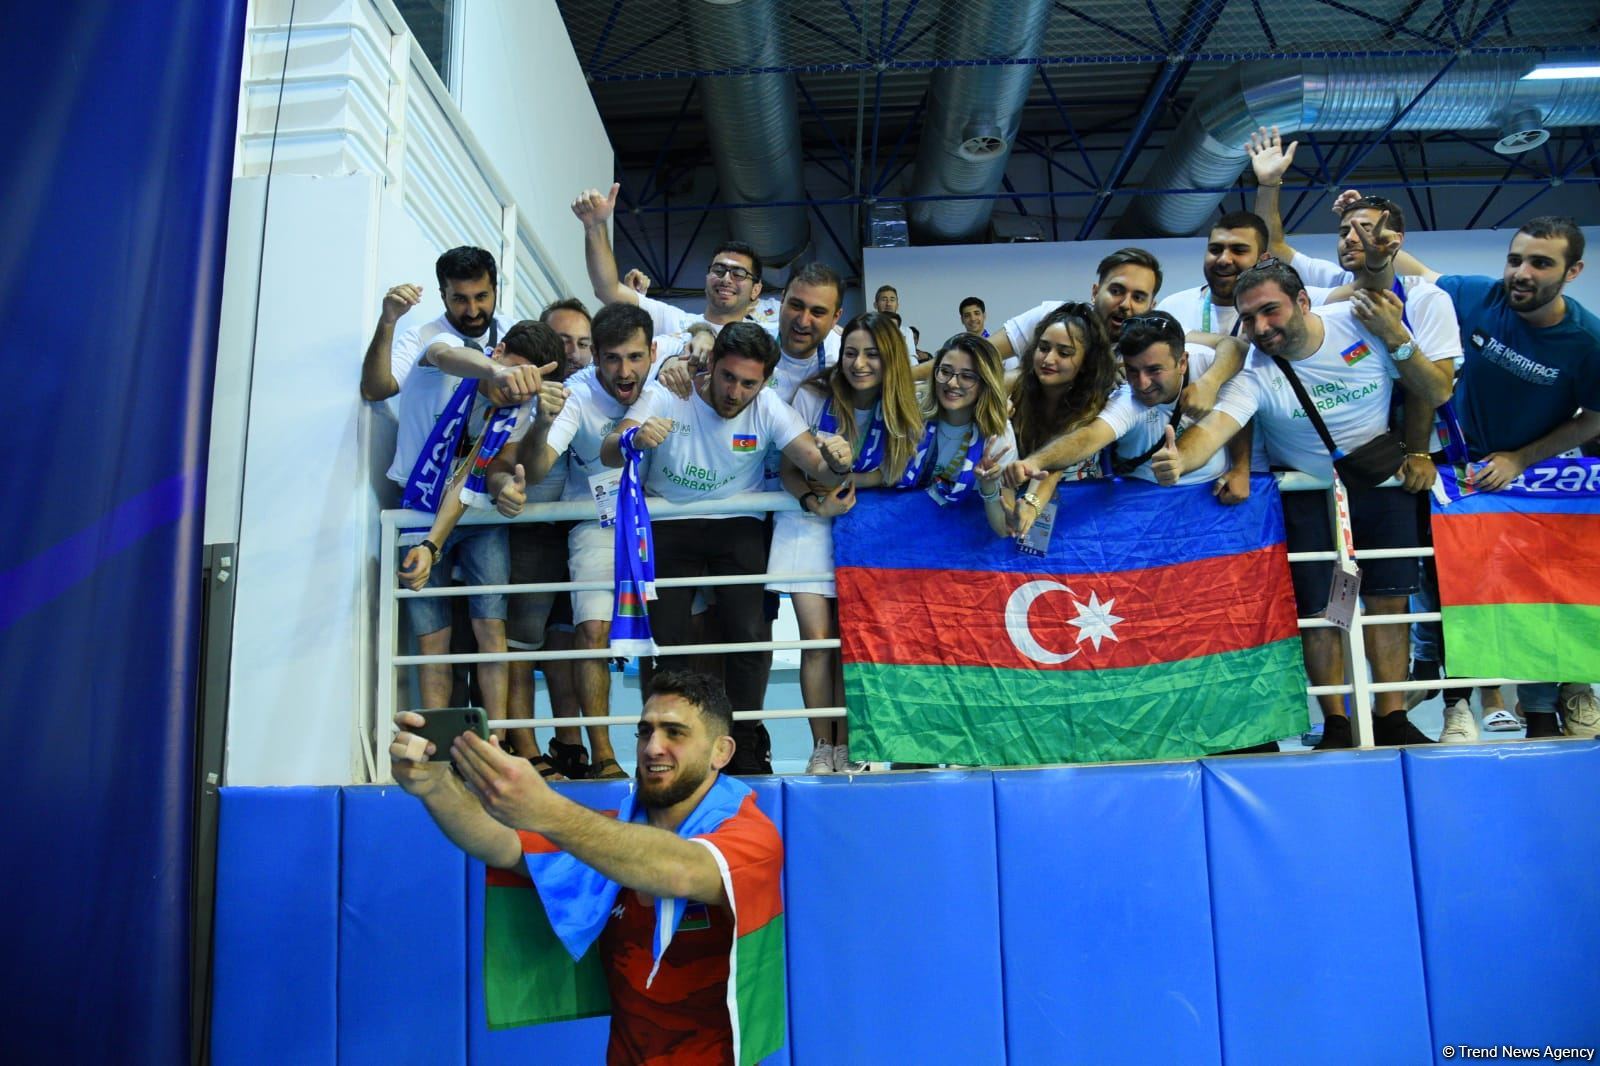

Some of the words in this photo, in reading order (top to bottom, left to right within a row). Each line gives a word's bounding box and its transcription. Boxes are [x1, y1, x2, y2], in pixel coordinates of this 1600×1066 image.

[1487, 337, 1506, 355] THE
[1502, 347, 1535, 371] NORTH
[1532, 363, 1560, 378] FACE
[1292, 381, 1378, 419] AZRBAYCAN
